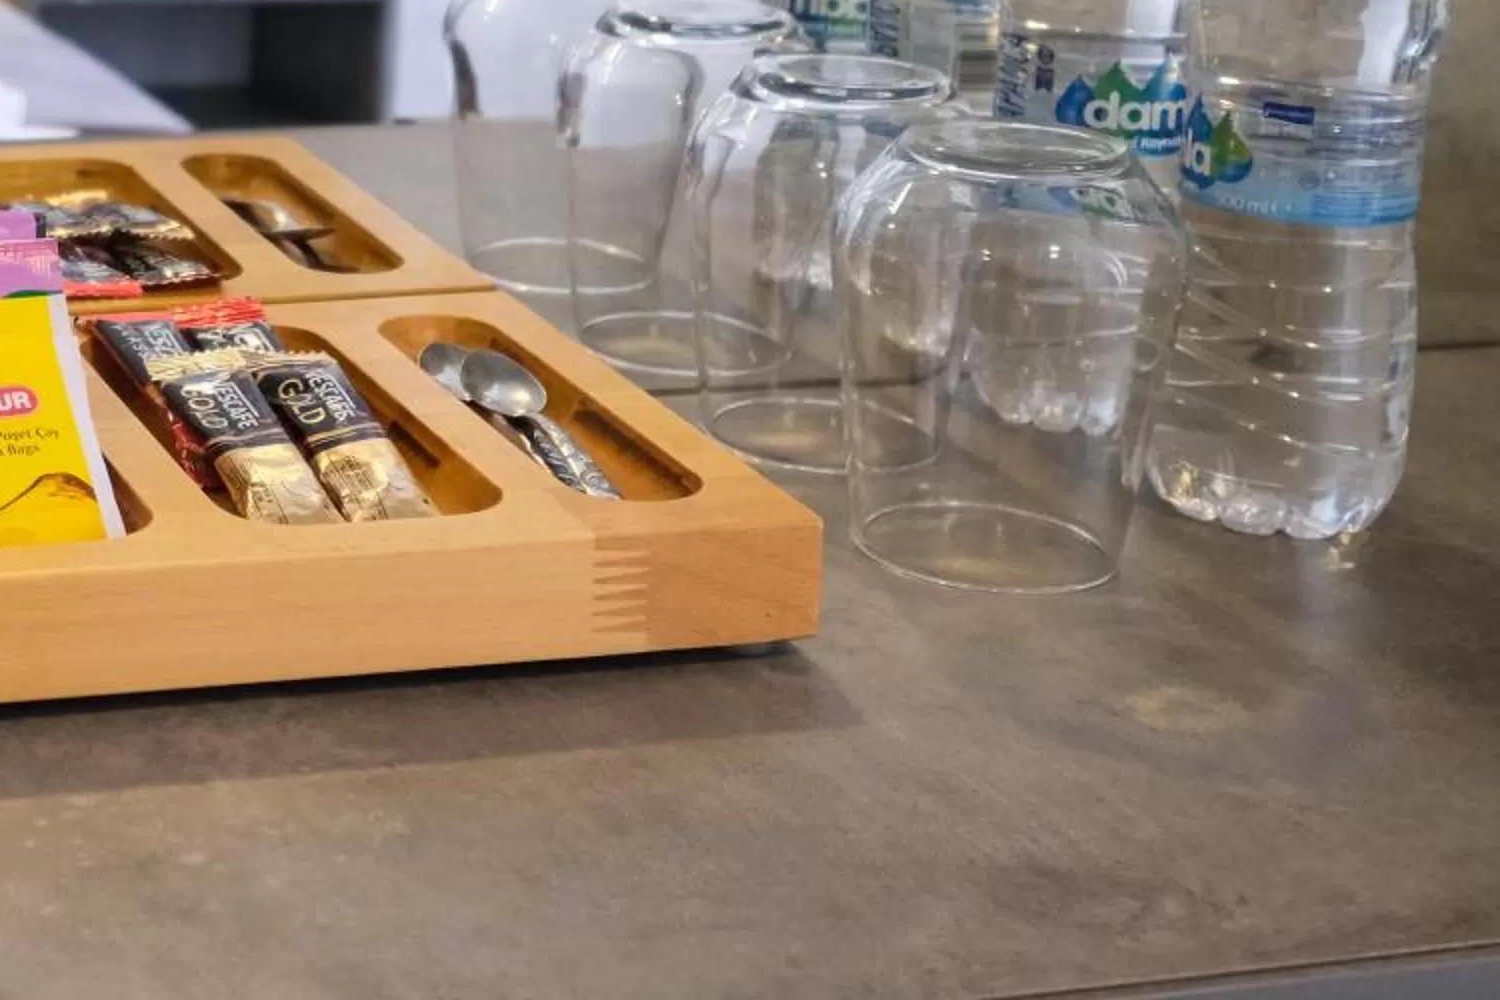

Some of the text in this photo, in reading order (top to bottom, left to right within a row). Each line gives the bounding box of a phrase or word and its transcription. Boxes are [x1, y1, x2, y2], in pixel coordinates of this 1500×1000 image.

[1083, 90, 1188, 131] dam
[179, 383, 229, 430] GOLD
[277, 378, 327, 425] GOLD
[8, 443, 40, 457] Bags
